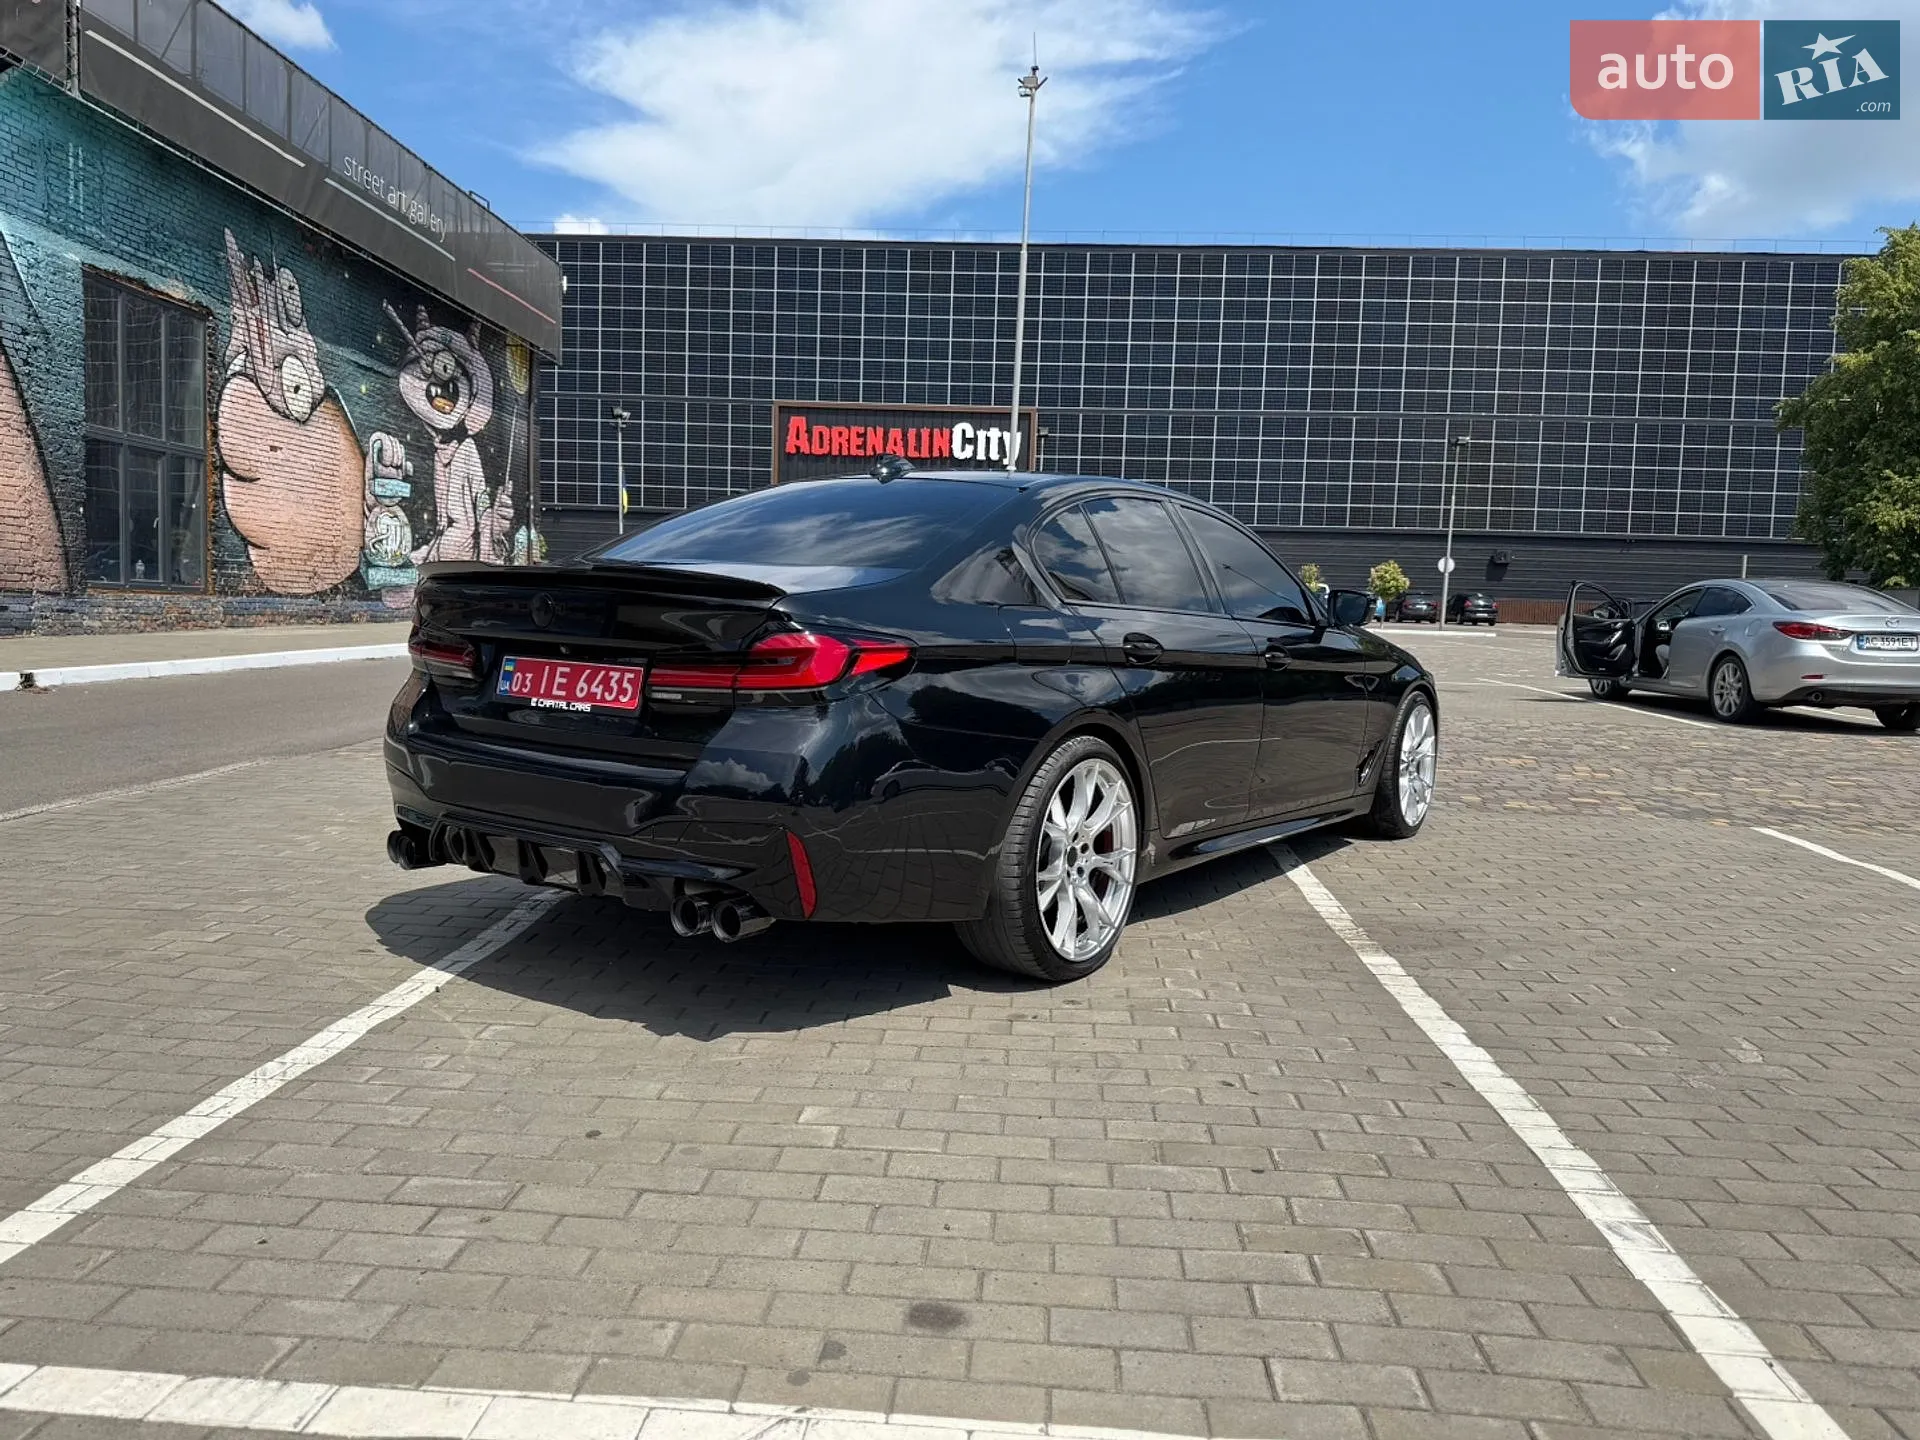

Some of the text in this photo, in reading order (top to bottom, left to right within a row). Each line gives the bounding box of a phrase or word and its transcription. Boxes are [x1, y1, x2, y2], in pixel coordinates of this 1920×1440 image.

[343, 156, 447, 243] street art gallery
[511, 665, 636, 703] 03 IE 6435
[569, 702, 592, 712] CARS
